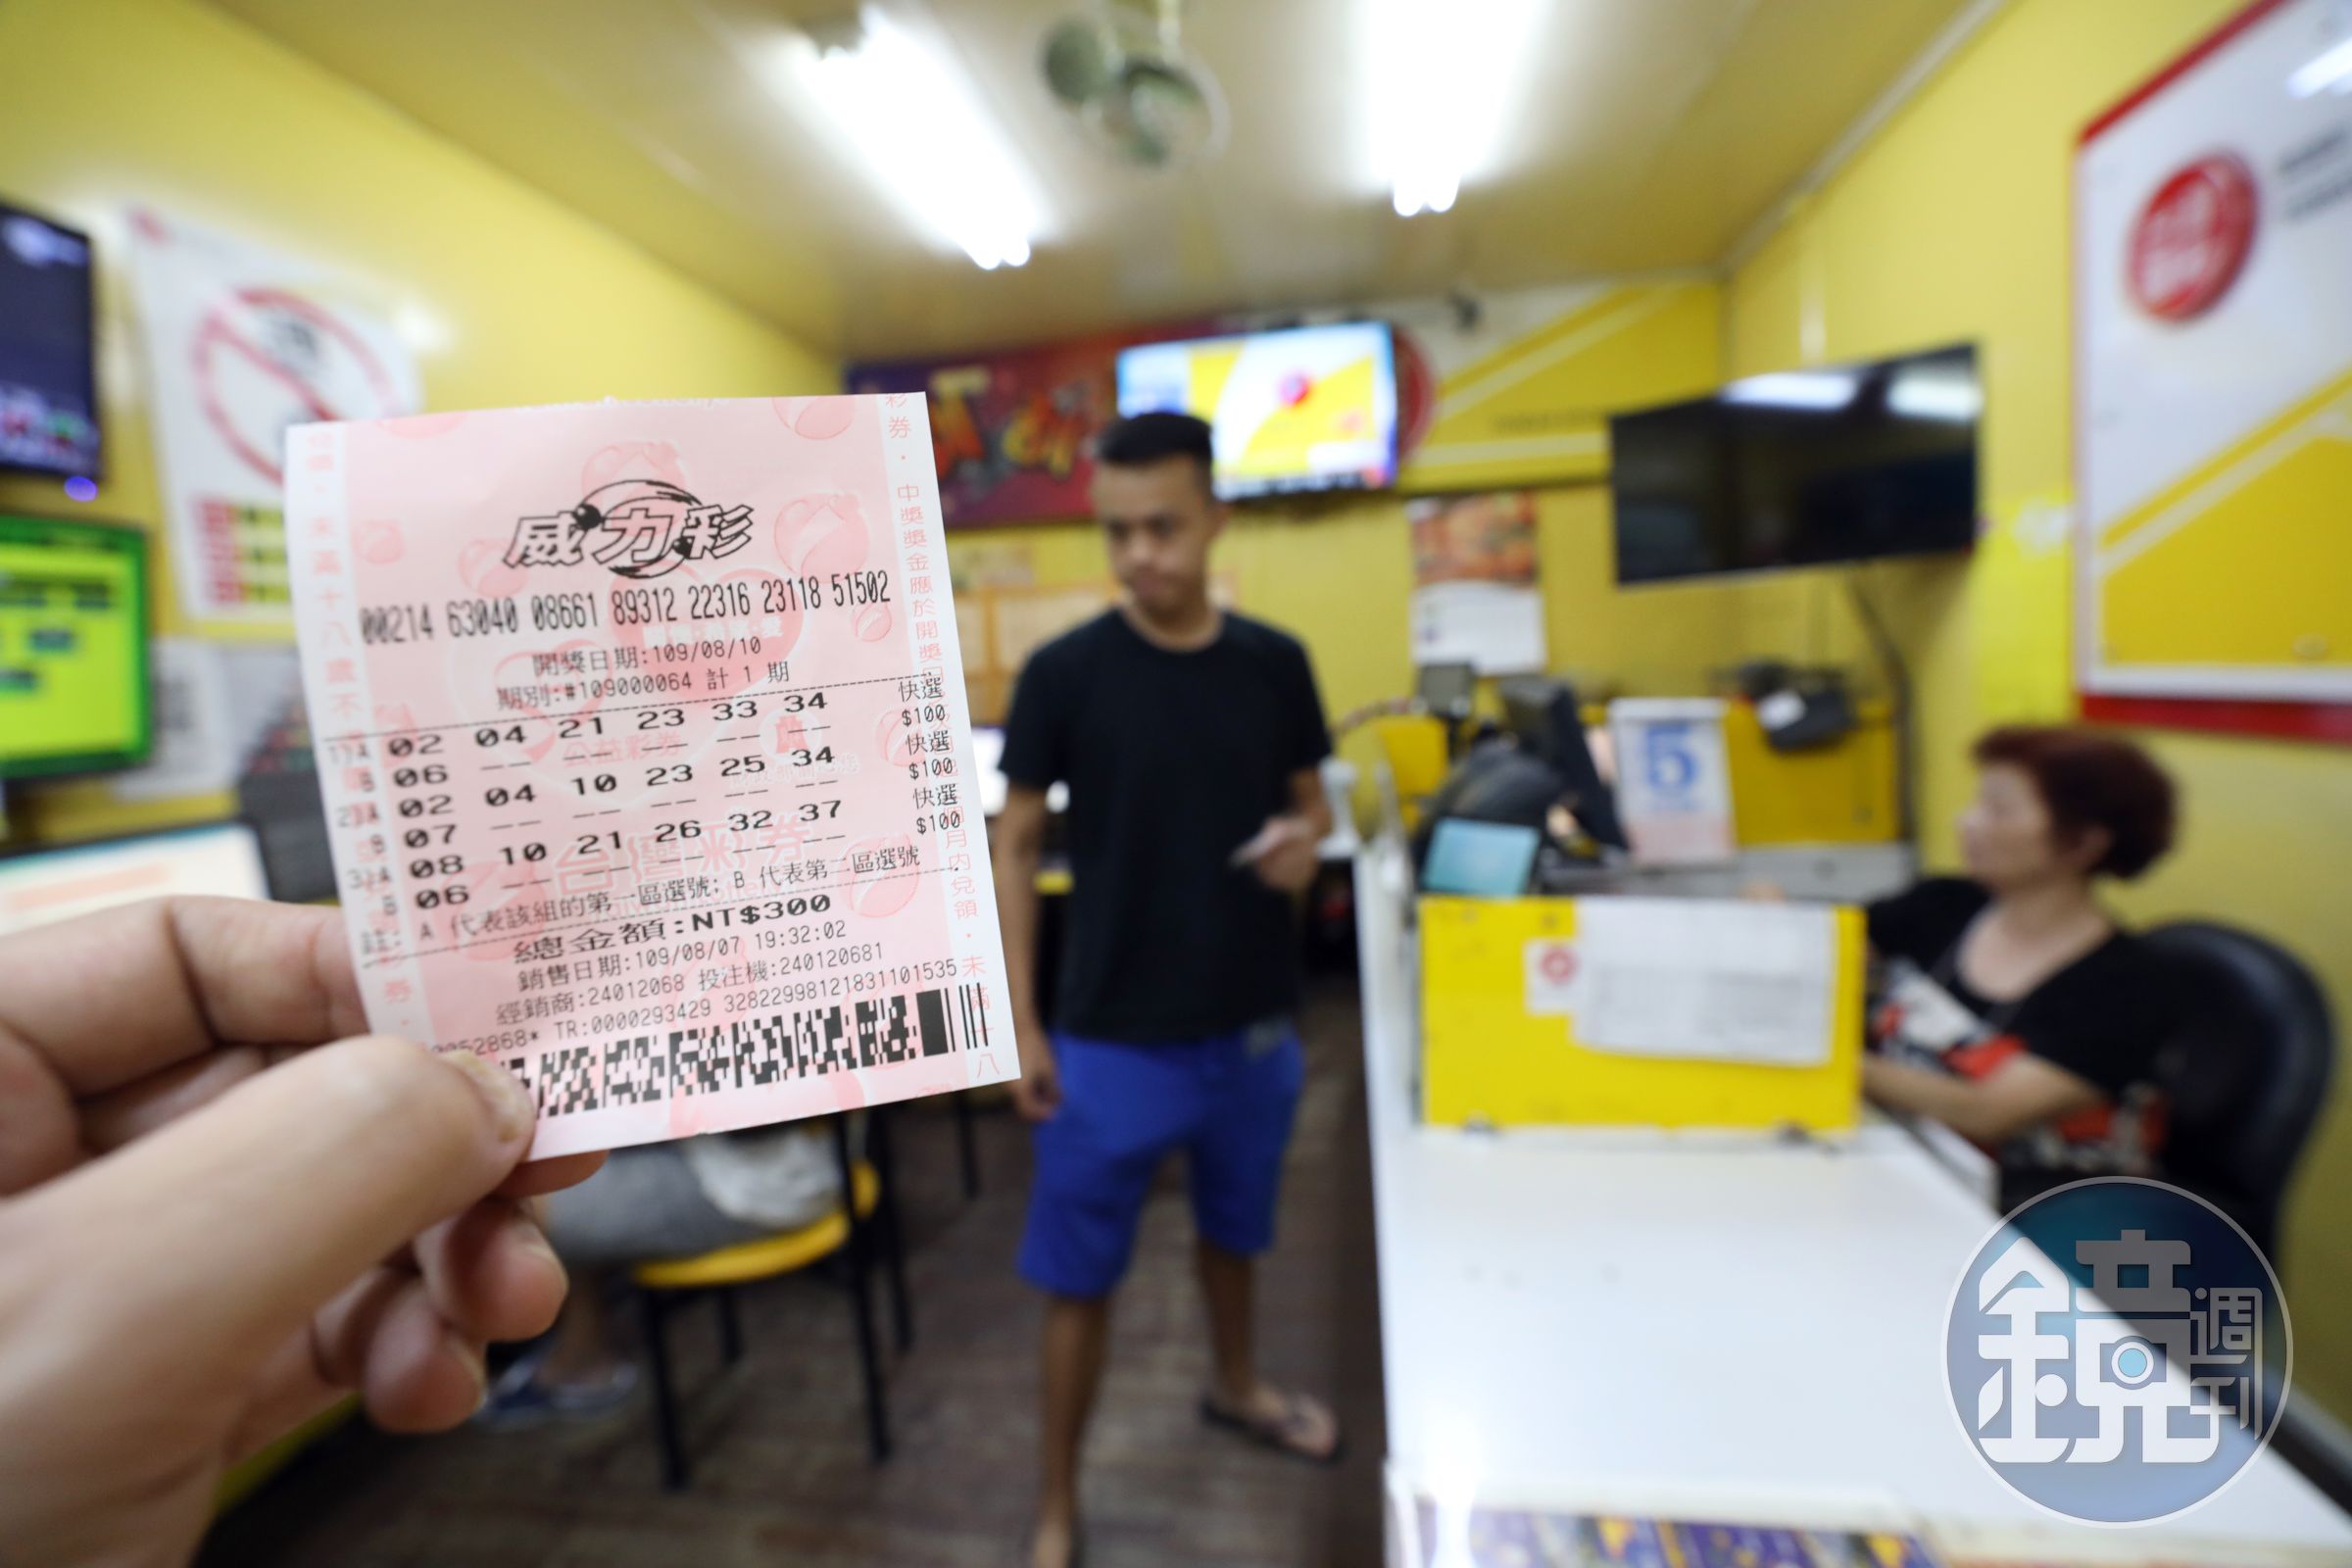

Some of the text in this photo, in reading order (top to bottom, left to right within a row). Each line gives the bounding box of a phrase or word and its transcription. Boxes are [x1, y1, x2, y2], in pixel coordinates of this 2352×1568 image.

[503, 505, 755, 568] 威力彩
[359, 569, 891, 645] 00214 63040 08661 89312 22316 23118 51502
[388, 734, 444, 758] 02
[475, 724, 527, 748] 04
[559, 716, 604, 739] 21
[637, 709, 686, 730] 23
[711, 700, 758, 721] 33
[784, 692, 828, 712] 34
[898, 676, 944, 703] 快選
[707, 668, 729, 691] 計
[743, 665, 752, 683] 1
[767, 661, 790, 684] 期
[393, 763, 449, 788] 06
[902, 704, 946, 727] $100
[399, 795, 454, 818] 02
[484, 784, 536, 808] 04
[571, 773, 618, 796] 10
[645, 763, 694, 787] 23
[719, 754, 766, 777] 25
[791, 746, 835, 767] 34
[906, 729, 951, 756] 快選
[403, 823, 457, 850] 07
[908, 757, 954, 780] $100
[410, 854, 465, 879] 08
[500, 842, 547, 866] 10
[576, 830, 621, 855] 21
[655, 820, 702, 843] 26
[727, 809, 773, 832] 32
[798, 800, 842, 821] 37
[912, 783, 958, 810] 快選
[415, 884, 469, 909] 06
[916, 810, 960, 835] $100
[420, 923, 434, 941] A
[733, 870, 746, 889] B
[755, 919, 847, 951] 19:32:02
[555, 1000, 711, 1042] TR:0000293429
[723, 956, 958, 1014] 32822998121831101535
